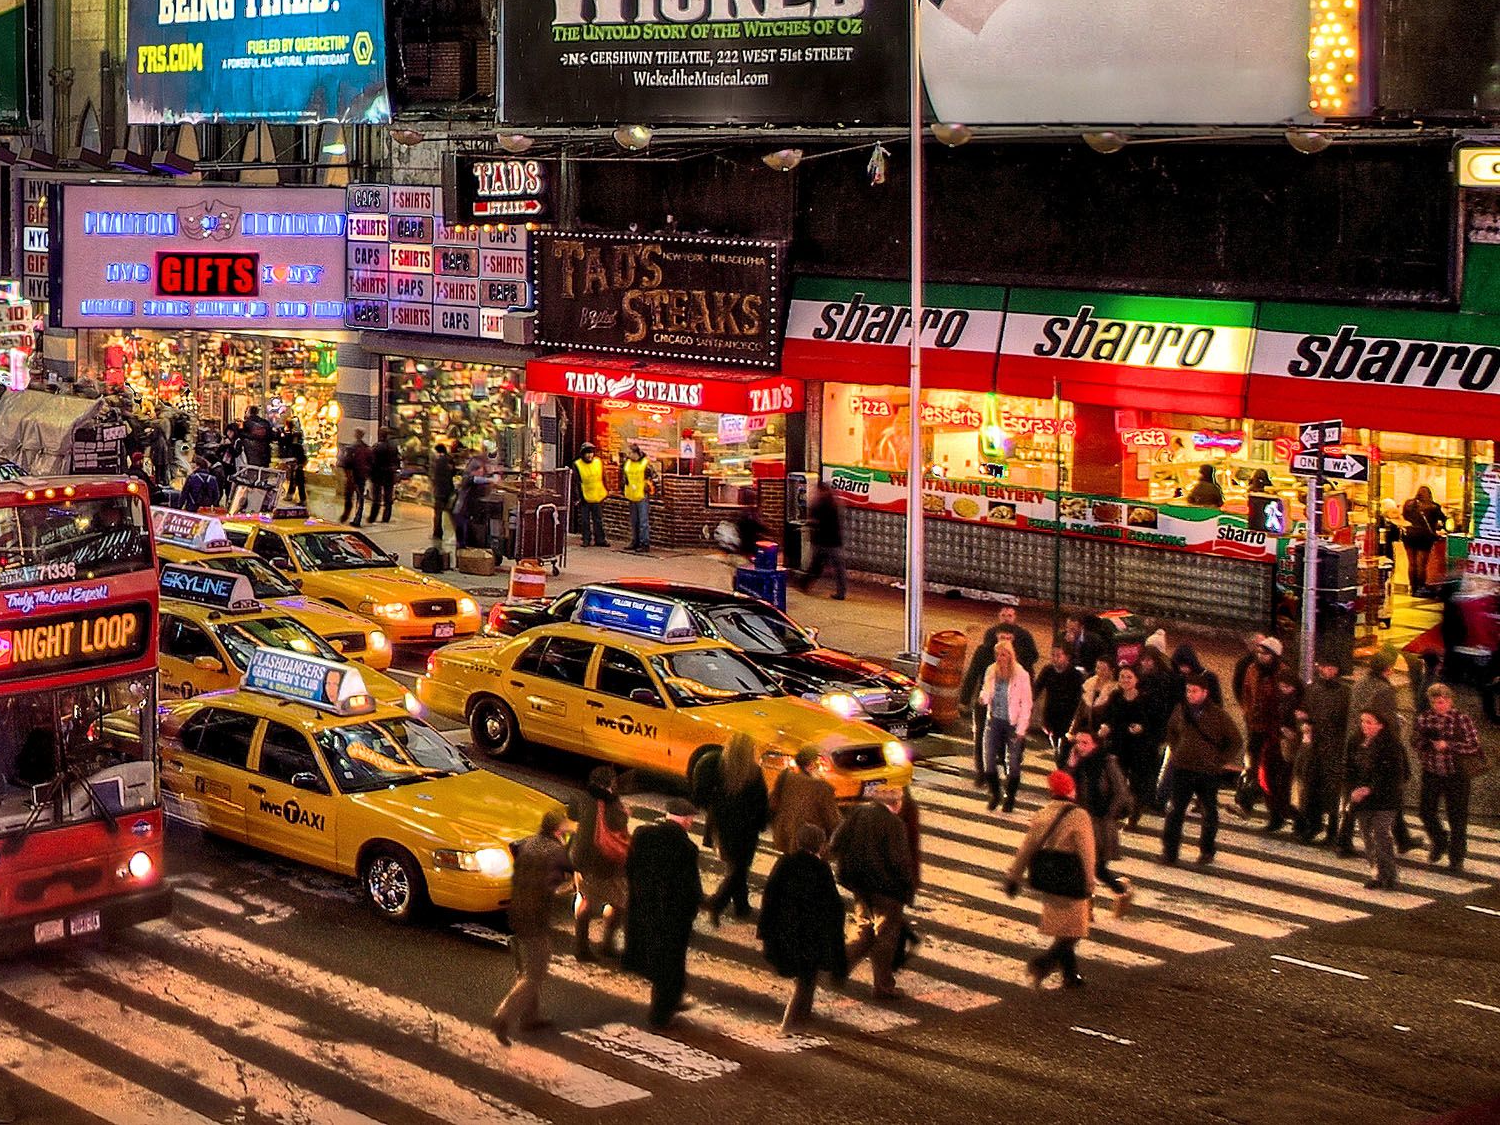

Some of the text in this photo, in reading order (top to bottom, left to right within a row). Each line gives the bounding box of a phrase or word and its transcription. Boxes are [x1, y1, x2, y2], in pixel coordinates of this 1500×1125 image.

[553, 18, 863, 43] THE UNTOLD STORY OF THE WITCHES OF OZ
[138, 43, 204, 74] FRS.COM
[247, 38, 293, 56] FUELED BY
[590, 46, 854, 68] GERSHWIN THEATRE, 222 WEST 51st STREET
[633, 69, 769, 87] WickedtheMusical.com
[355, 190, 431, 211] CAPS T-SHIRTS
[349, 215, 424, 239] T-SHIRTS CAPS
[354, 247, 525, 275] CAPS T-SHIRTS CAPS T-SHIRTS
[553, 239, 663, 300] TAD'S
[160, 256, 255, 293] GIFTS
[349, 276, 518, 303] T-SHIRTS CAPS T-SHIRTS CAPS
[354, 304, 470, 331] CAPS T-SHIRTS CAPS
[621, 288, 763, 344] STEAKS
[812, 292, 971, 350] sbarro
[653, 332, 694, 346] CHICAGO
[1033, 304, 1216, 369] sbarro
[1288, 324, 1500, 392] sbarro
[565, 371, 701, 406] TAD'S STEAKS
[750, 383, 794, 413] TAD'S
[850, 395, 889, 417] Pizza
[1331, 460, 1357, 473] WAY
[831, 474, 871, 495] sbarro
[921, 480, 1046, 505] ITALIAN EATERY
[1217, 524, 1266, 546] sbarro
[38, 562, 77, 581] 71336
[161, 571, 232, 597] SKYLINE
[12, 612, 137, 663] NIGHT LOOP
[251, 666, 319, 690] GENTLEMEN'S CLUB
[252, 652, 326, 680] FLASHDANCERS
